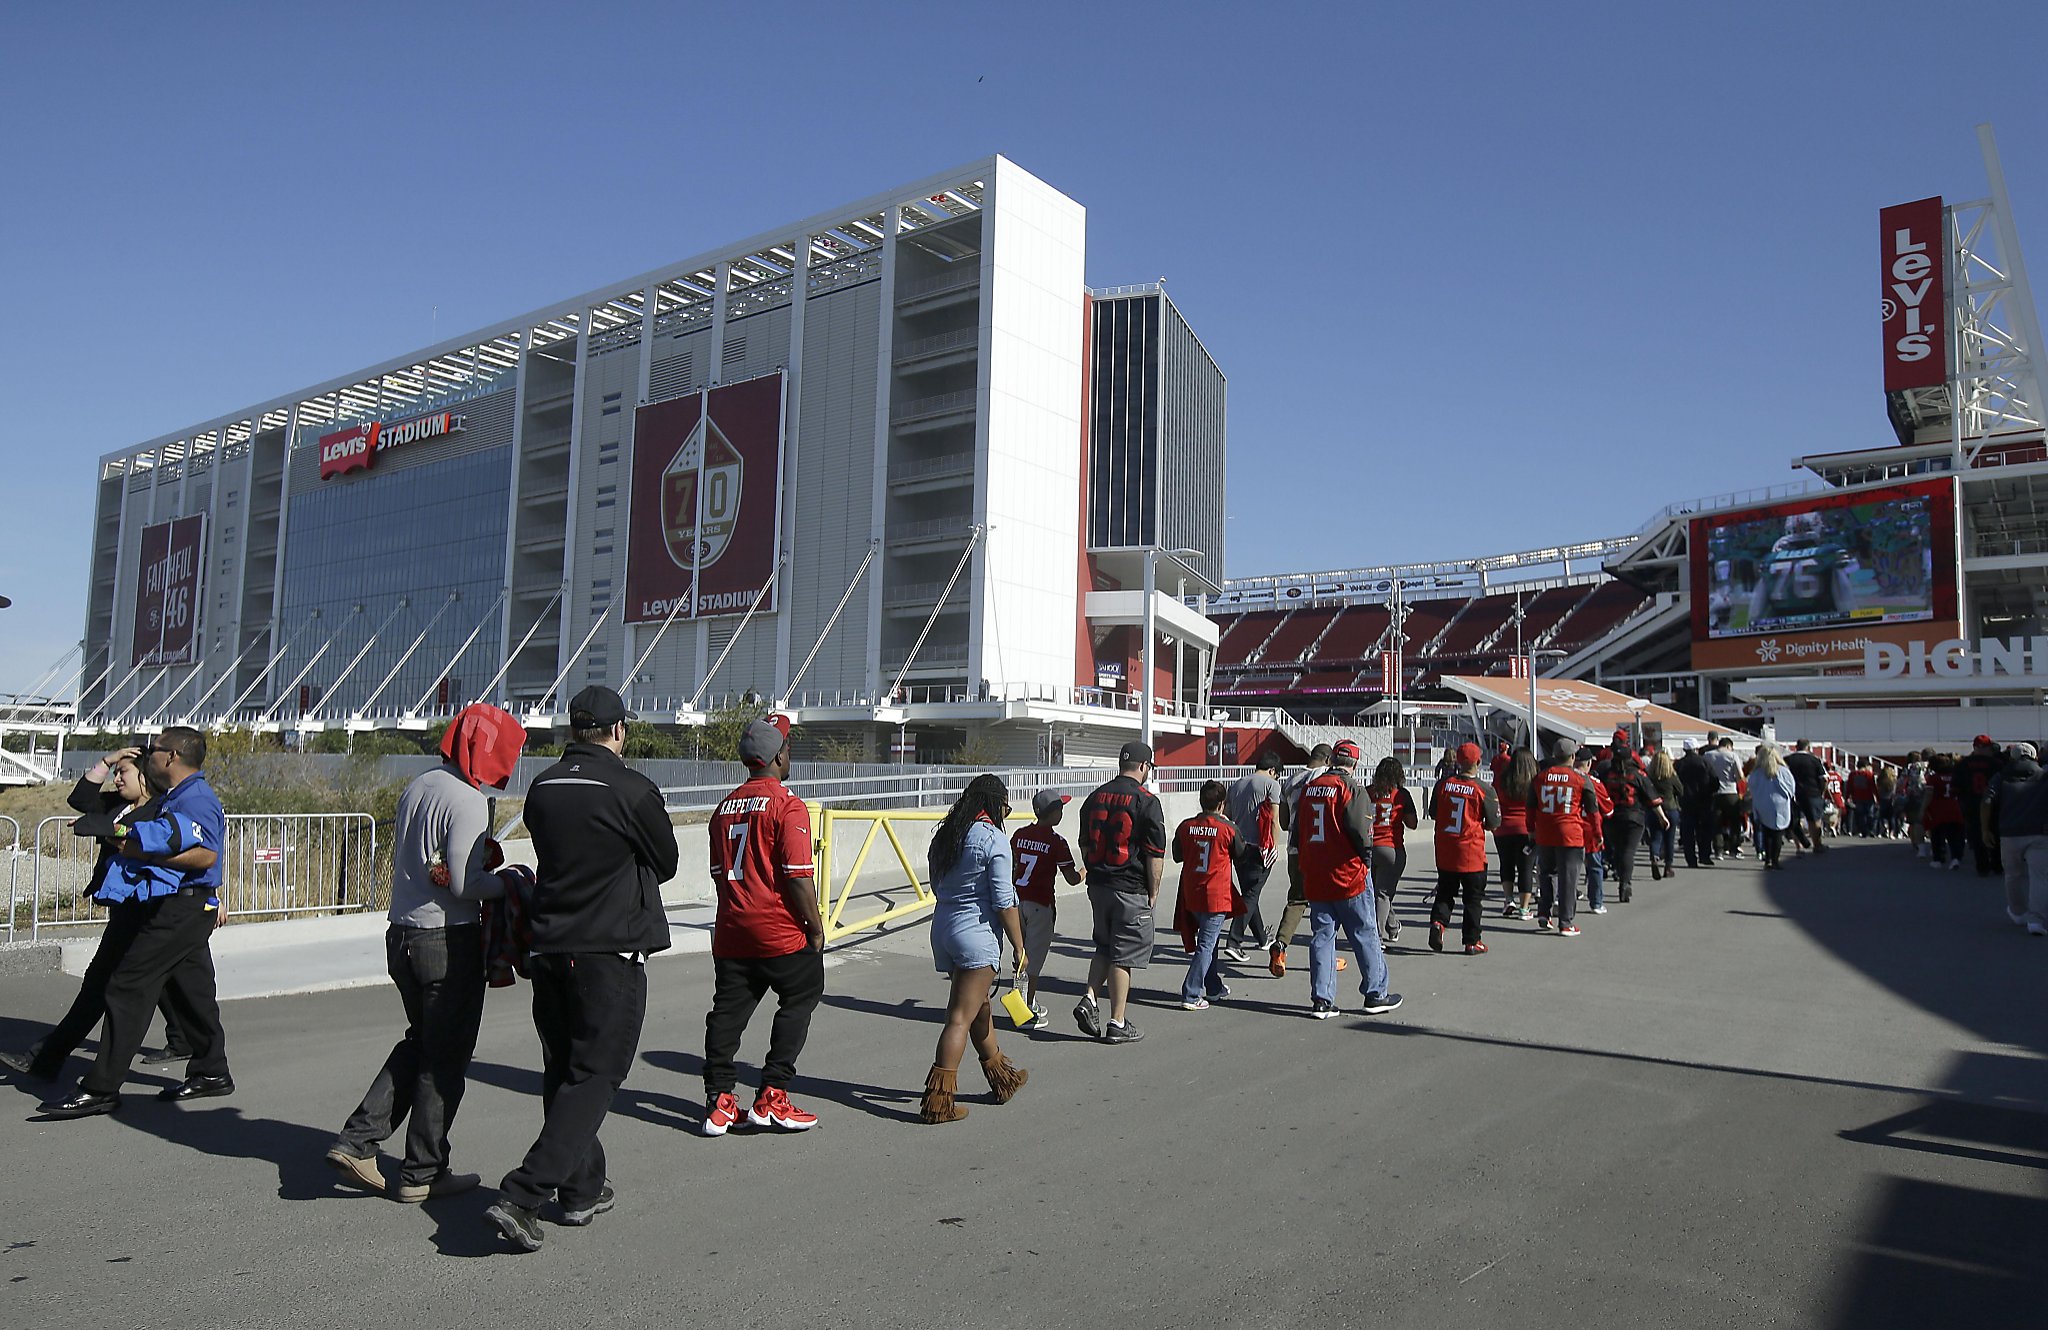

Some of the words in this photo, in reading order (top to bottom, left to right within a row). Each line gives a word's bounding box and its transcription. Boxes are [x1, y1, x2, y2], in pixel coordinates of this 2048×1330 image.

[1891, 228, 1935, 362] Levi's
[323, 436, 366, 462] Levi's
[376, 413, 447, 451] STADIUM
[146, 545, 192, 597] FAITHFUL
[1769, 558, 1820, 600] 76
[699, 589, 760, 611] STADIUM
[1785, 642, 1829, 656] Dignity
[1831, 637, 1873, 652] Health
[1305, 785, 1337, 798] WINSTON
[1444, 782, 1475, 795] WINSTON
[1547, 773, 1569, 782] DAVID
[1444, 796, 1466, 834] 3
[1541, 785, 1573, 814] 54
[1087, 809, 1133, 866] 53
[1189, 825, 1218, 837] WINSTON
[1310, 803, 1325, 842] 3
[727, 822, 749, 881] 7
[1194, 840, 1210, 872] 3
[1015, 853, 1038, 887] 7
